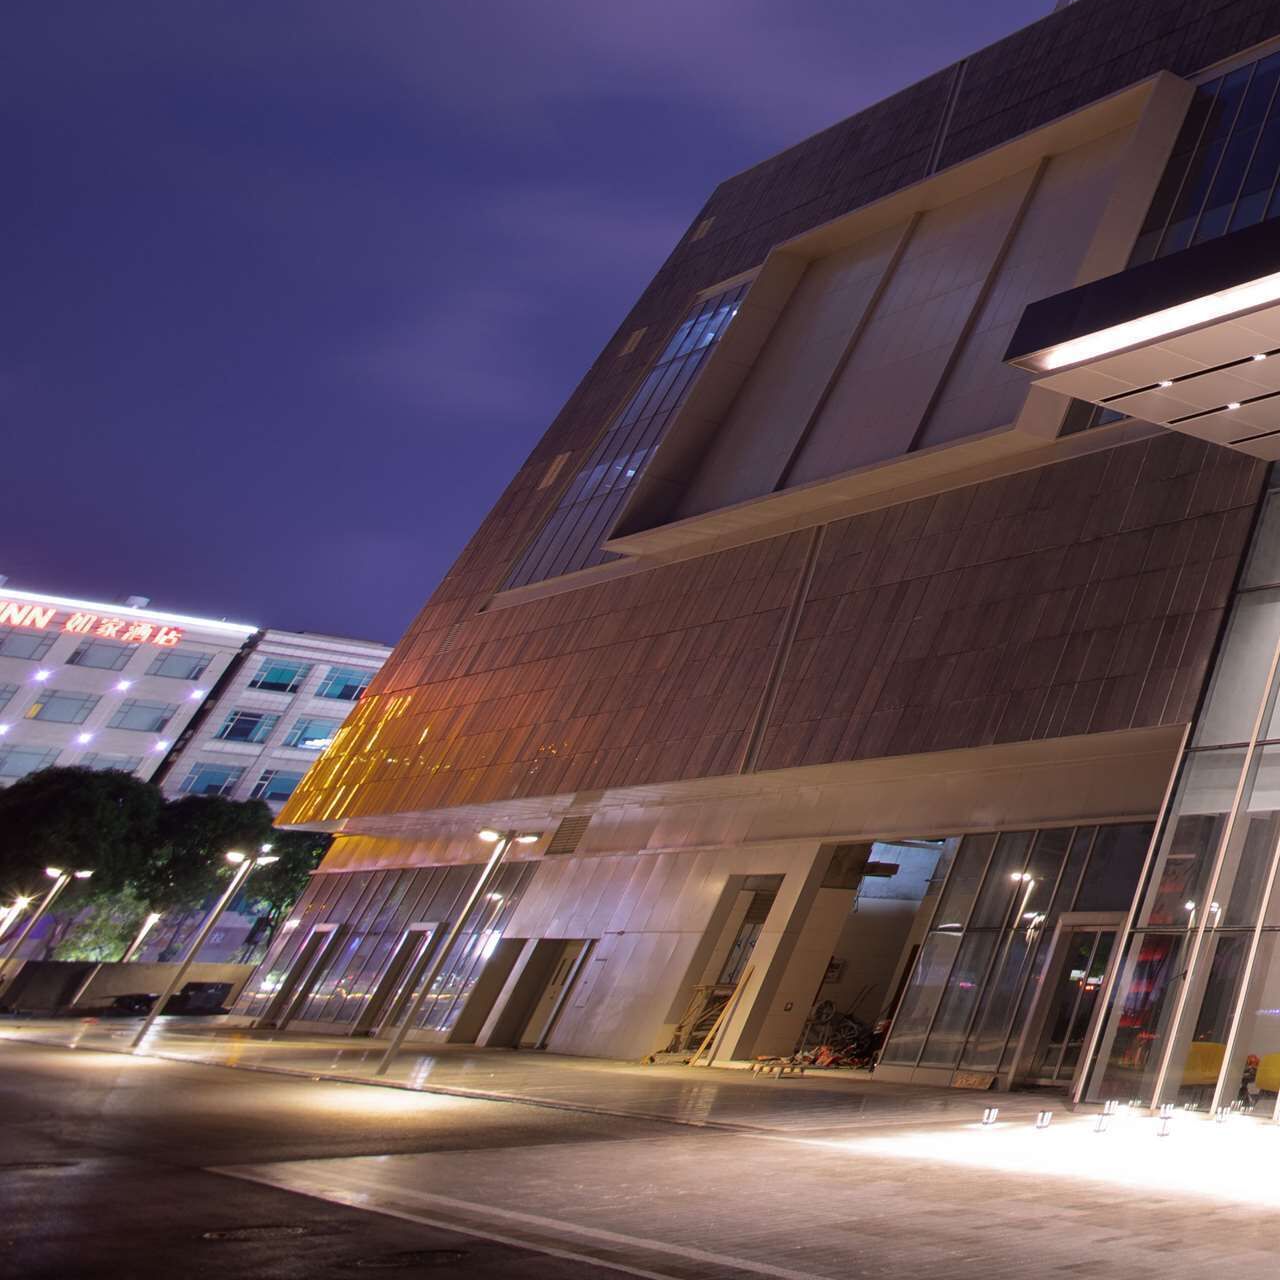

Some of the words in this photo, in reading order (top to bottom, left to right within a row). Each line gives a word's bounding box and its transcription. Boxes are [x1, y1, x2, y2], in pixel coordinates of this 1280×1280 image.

[0, 601, 57, 629] NN
[64, 612, 182, 646] 如家酒店
